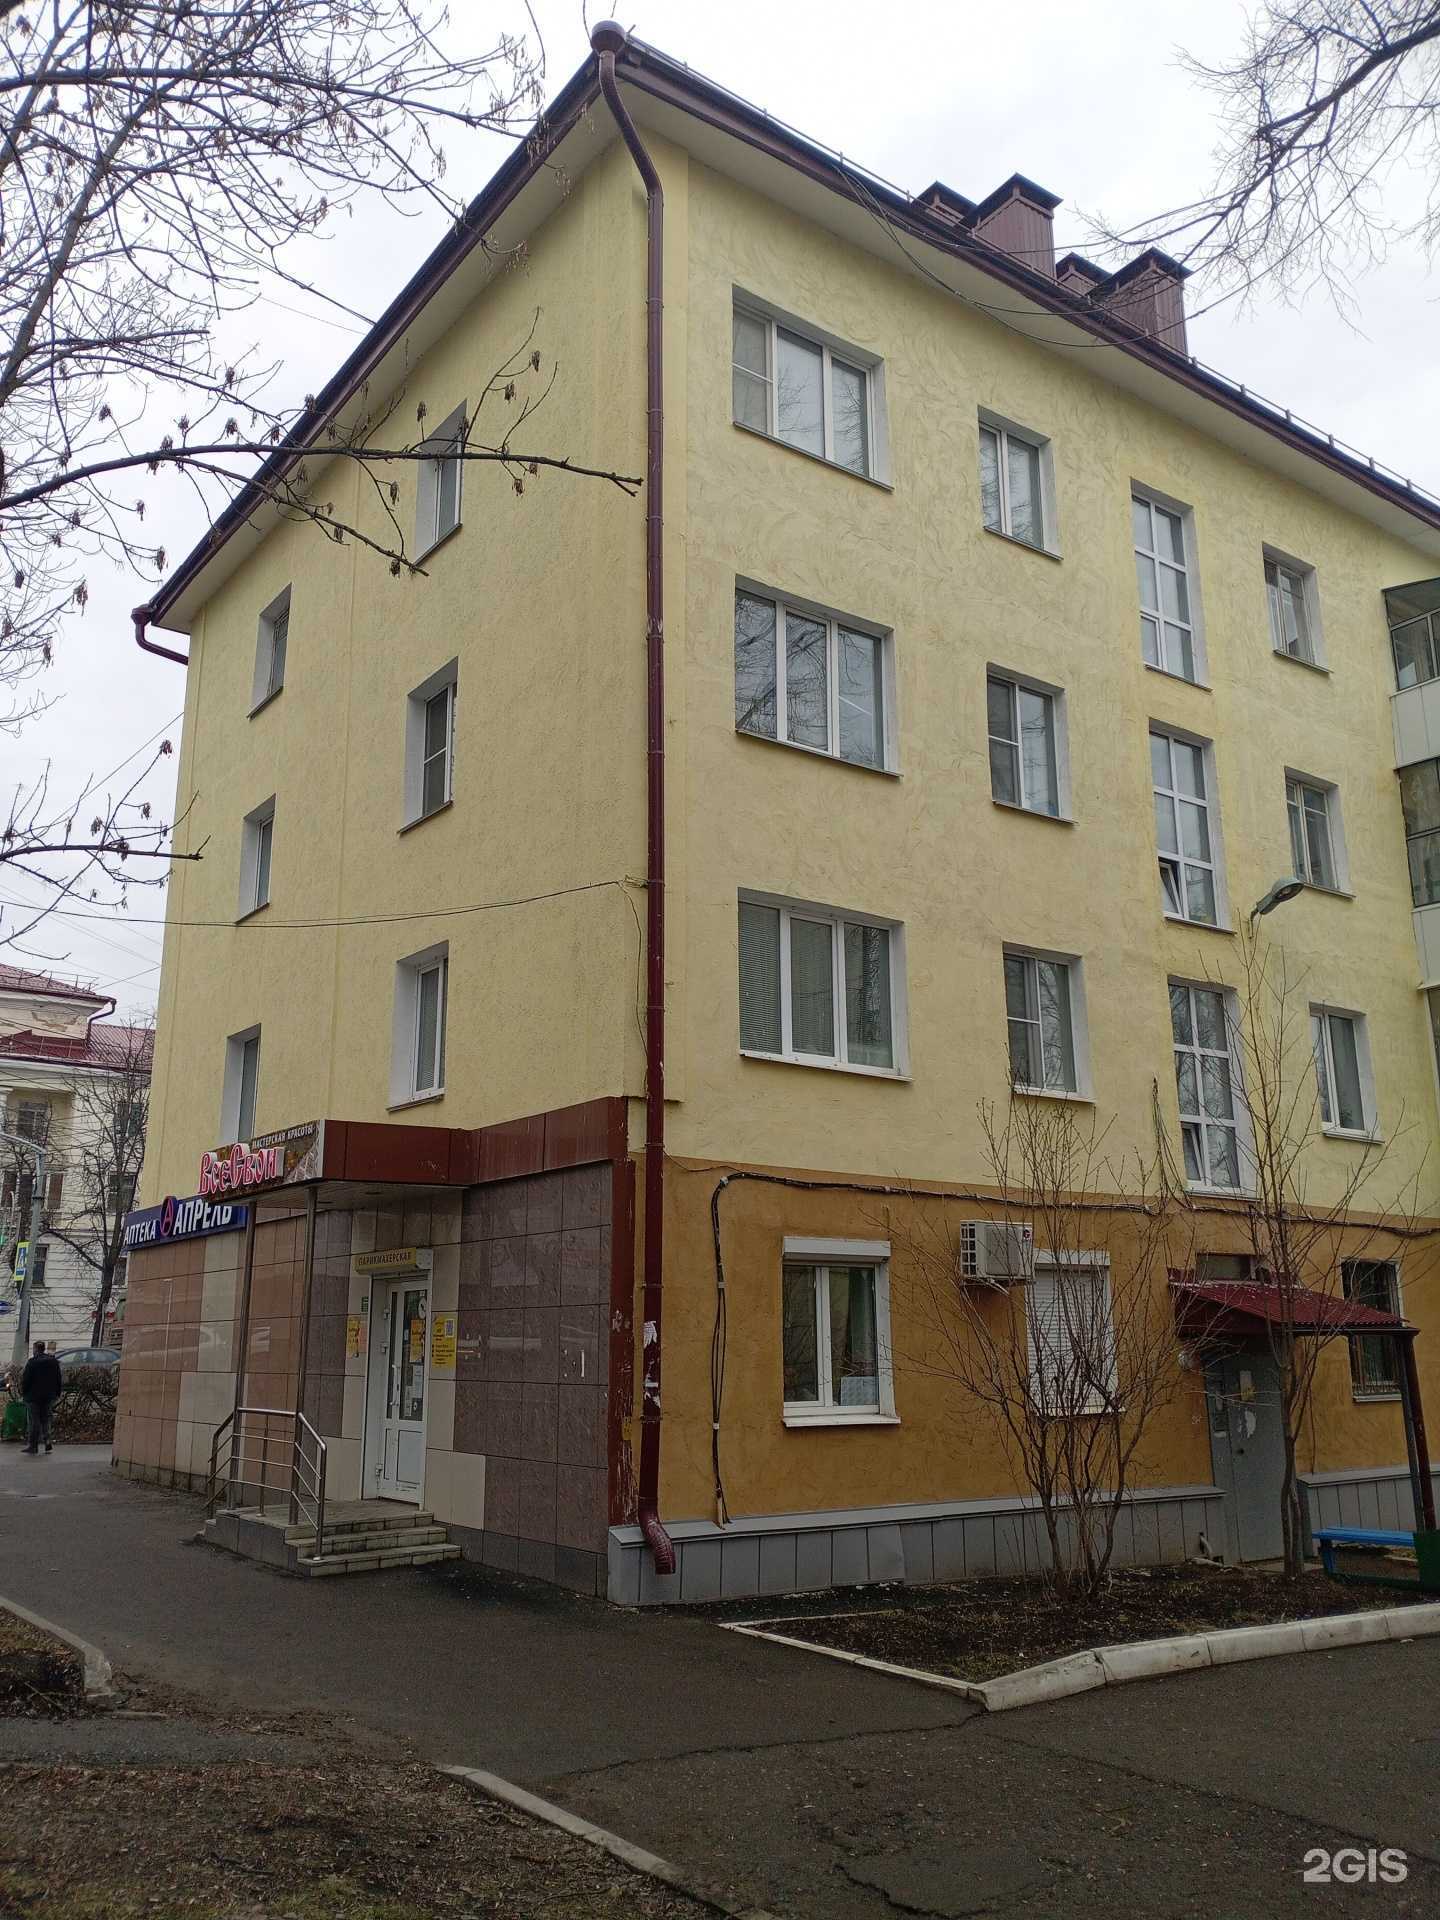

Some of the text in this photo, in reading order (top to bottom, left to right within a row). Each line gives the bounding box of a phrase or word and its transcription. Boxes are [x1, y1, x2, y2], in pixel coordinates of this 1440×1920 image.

[287, 1124, 313, 1140] КРАСОТЫ
[172, 1198, 233, 1236] АПРЕЛЬ
[123, 1219, 156, 1246] АПТЕКА
[358, 1252, 410, 1265] ПАРИКМАХЕРСКАЯ
